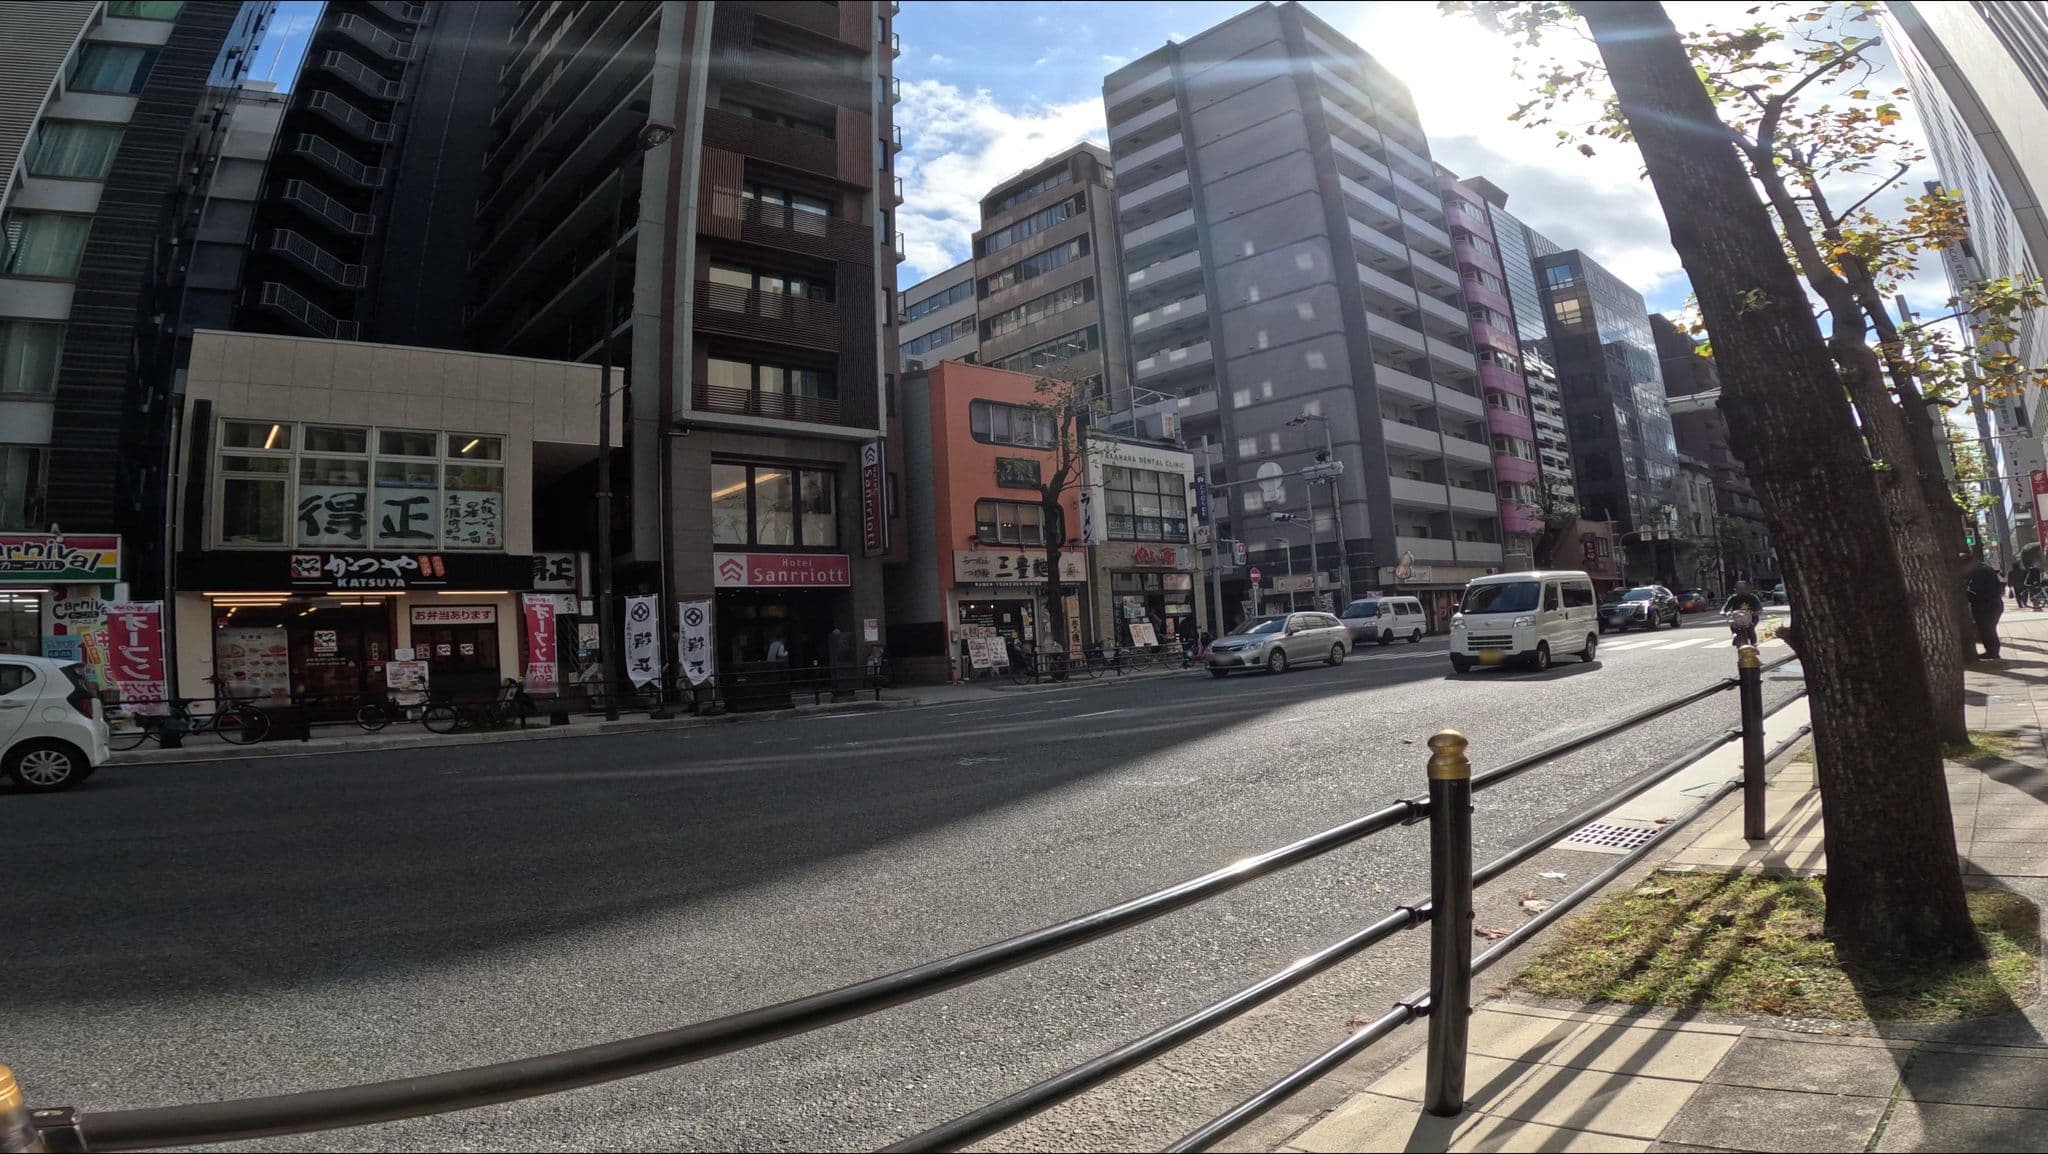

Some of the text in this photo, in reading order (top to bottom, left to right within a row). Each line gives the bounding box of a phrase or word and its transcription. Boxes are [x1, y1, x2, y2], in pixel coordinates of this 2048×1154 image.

[1139, 456, 1164, 467] DENTAL
[865, 467, 876, 547] Sanrriott
[1080, 493, 1093, 543] ラーメン
[0, 540, 102, 571] rnival
[782, 557, 812, 566] Hotel
[1, 560, 61, 570] カーニバル
[323, 553, 418, 578] かつや
[753, 566, 845, 582] Sanrriott
[337, 578, 406, 588] KATSUYA
[53, 598, 108, 619] Carniva
[415, 610, 493, 620] お弁当あります
